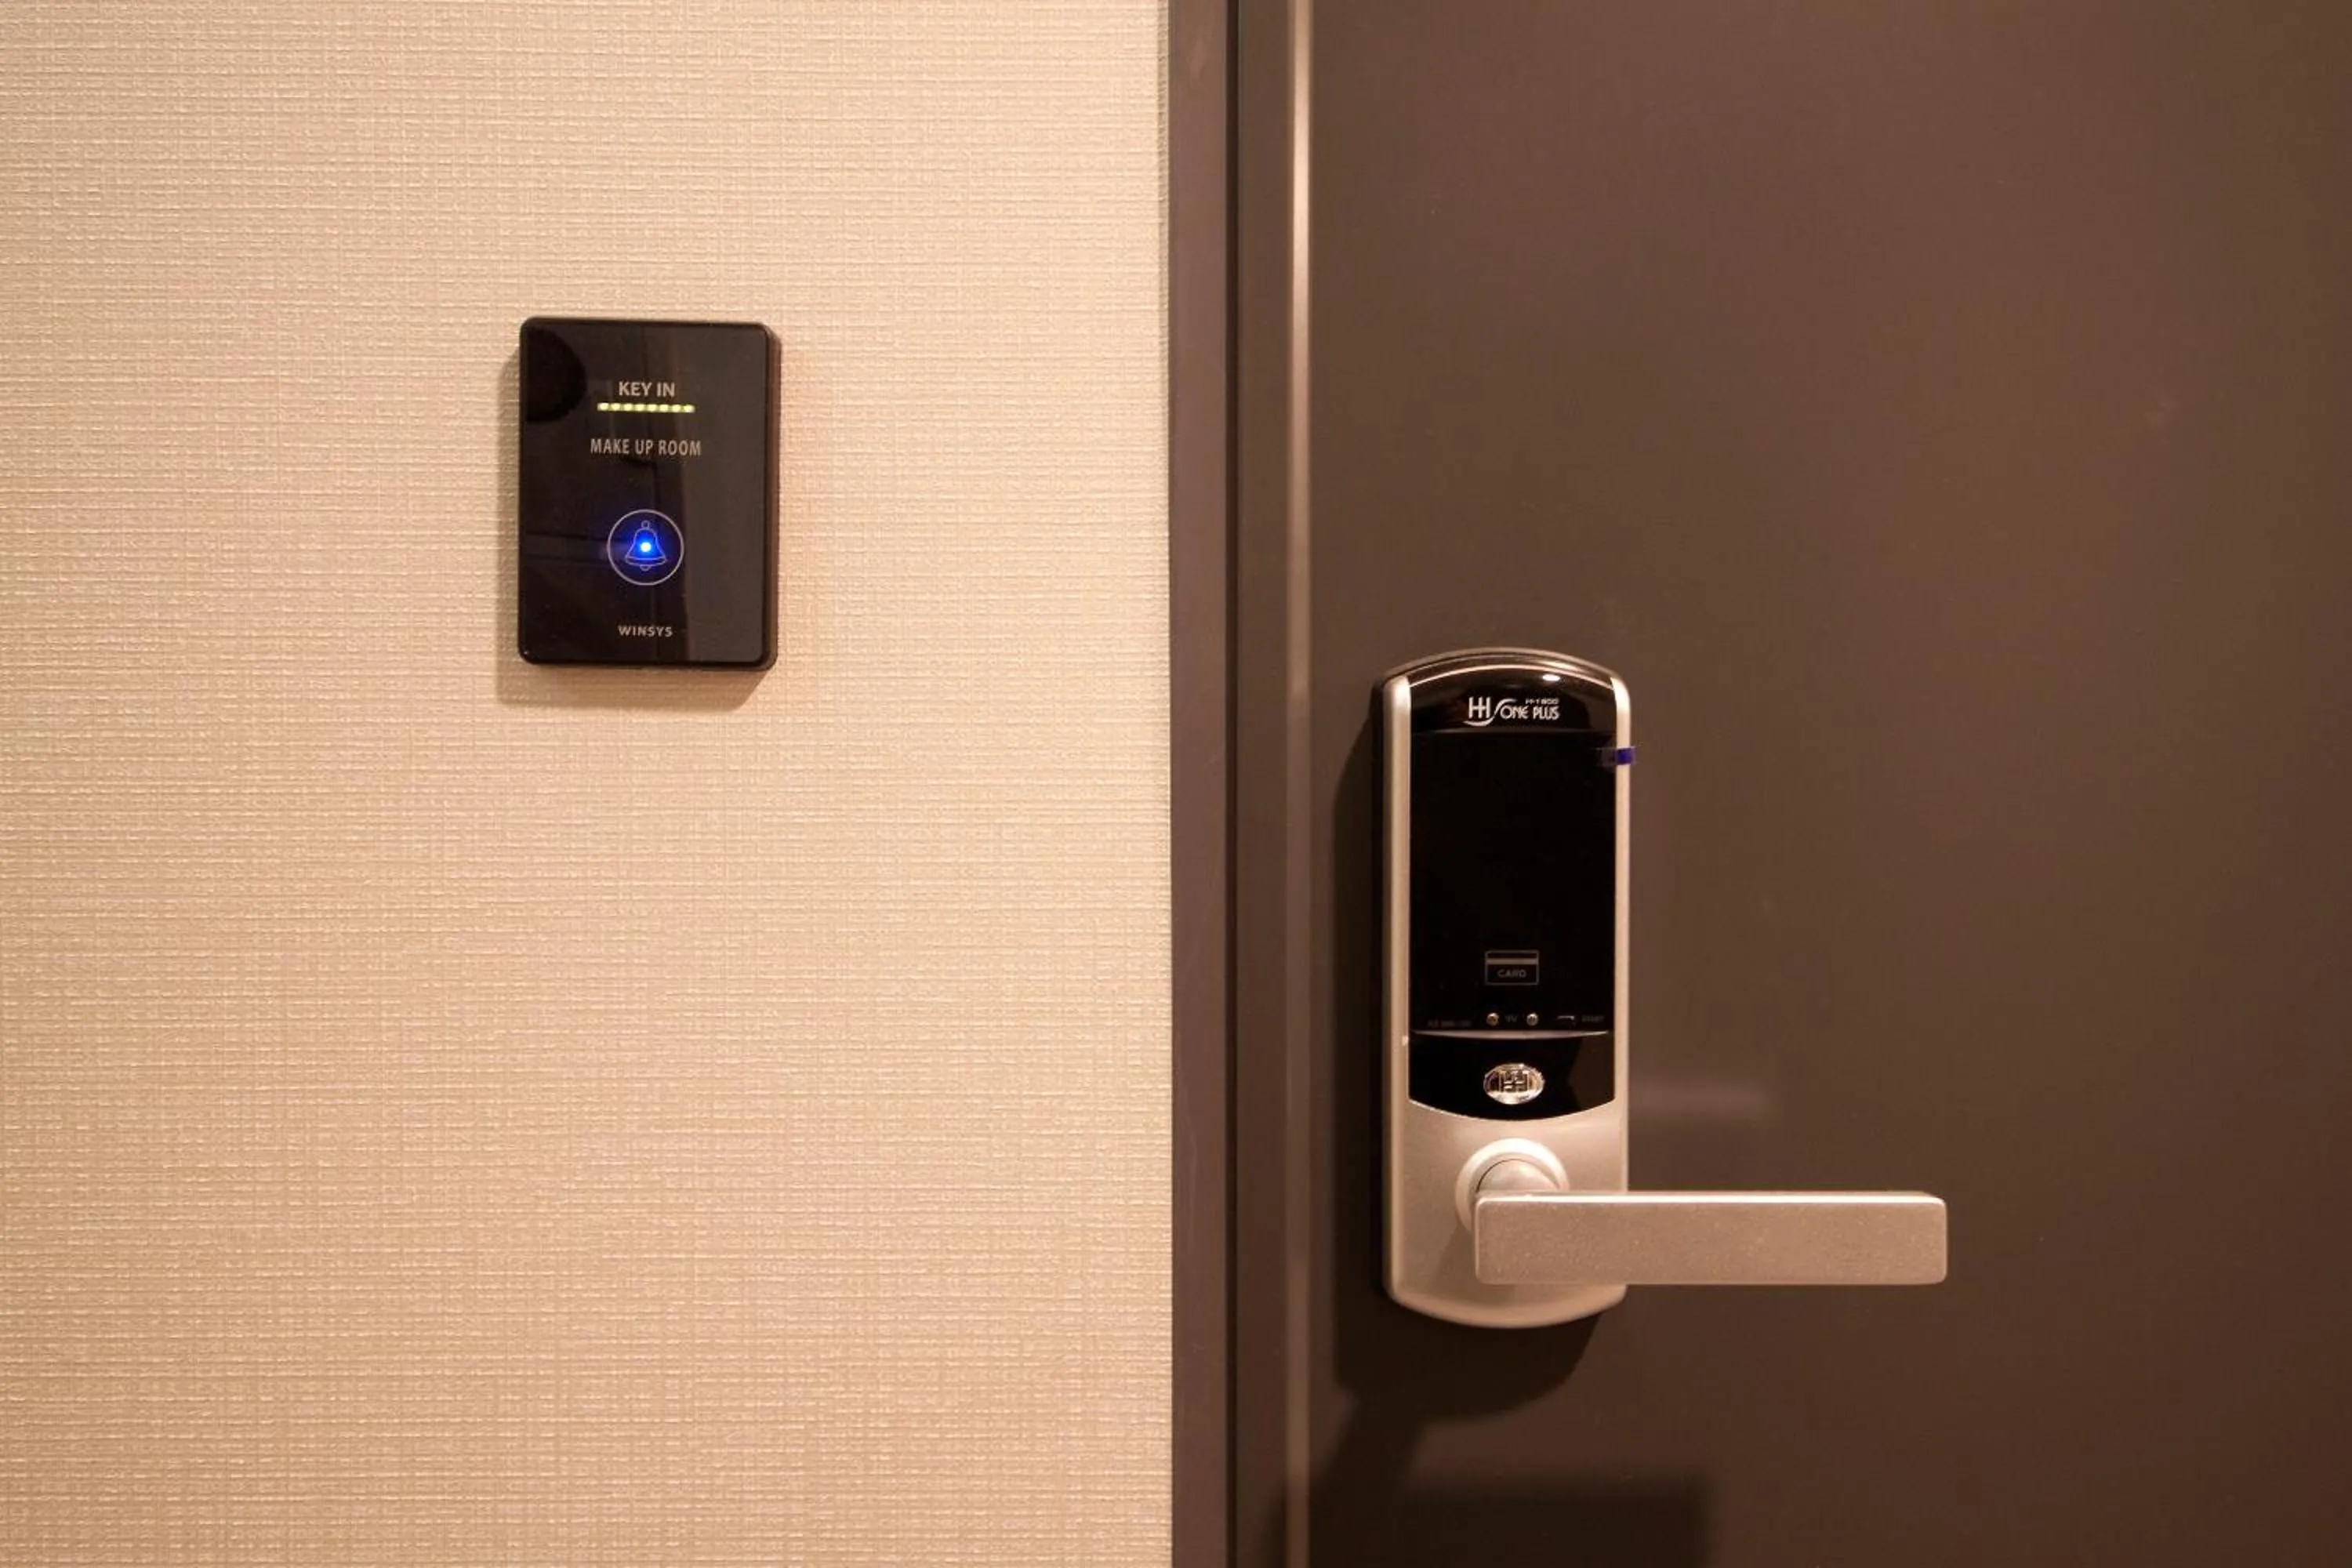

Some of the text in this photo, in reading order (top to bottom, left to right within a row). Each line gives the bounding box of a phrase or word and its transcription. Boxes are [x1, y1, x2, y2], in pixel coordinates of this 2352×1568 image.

[618, 382, 675, 397] KEY IN
[590, 438, 702, 456] MAKE UP ROOM
[618, 625, 673, 637] WINSYS
[1533, 706, 1559, 720] PLUS
[1497, 969, 1526, 978] CARD
